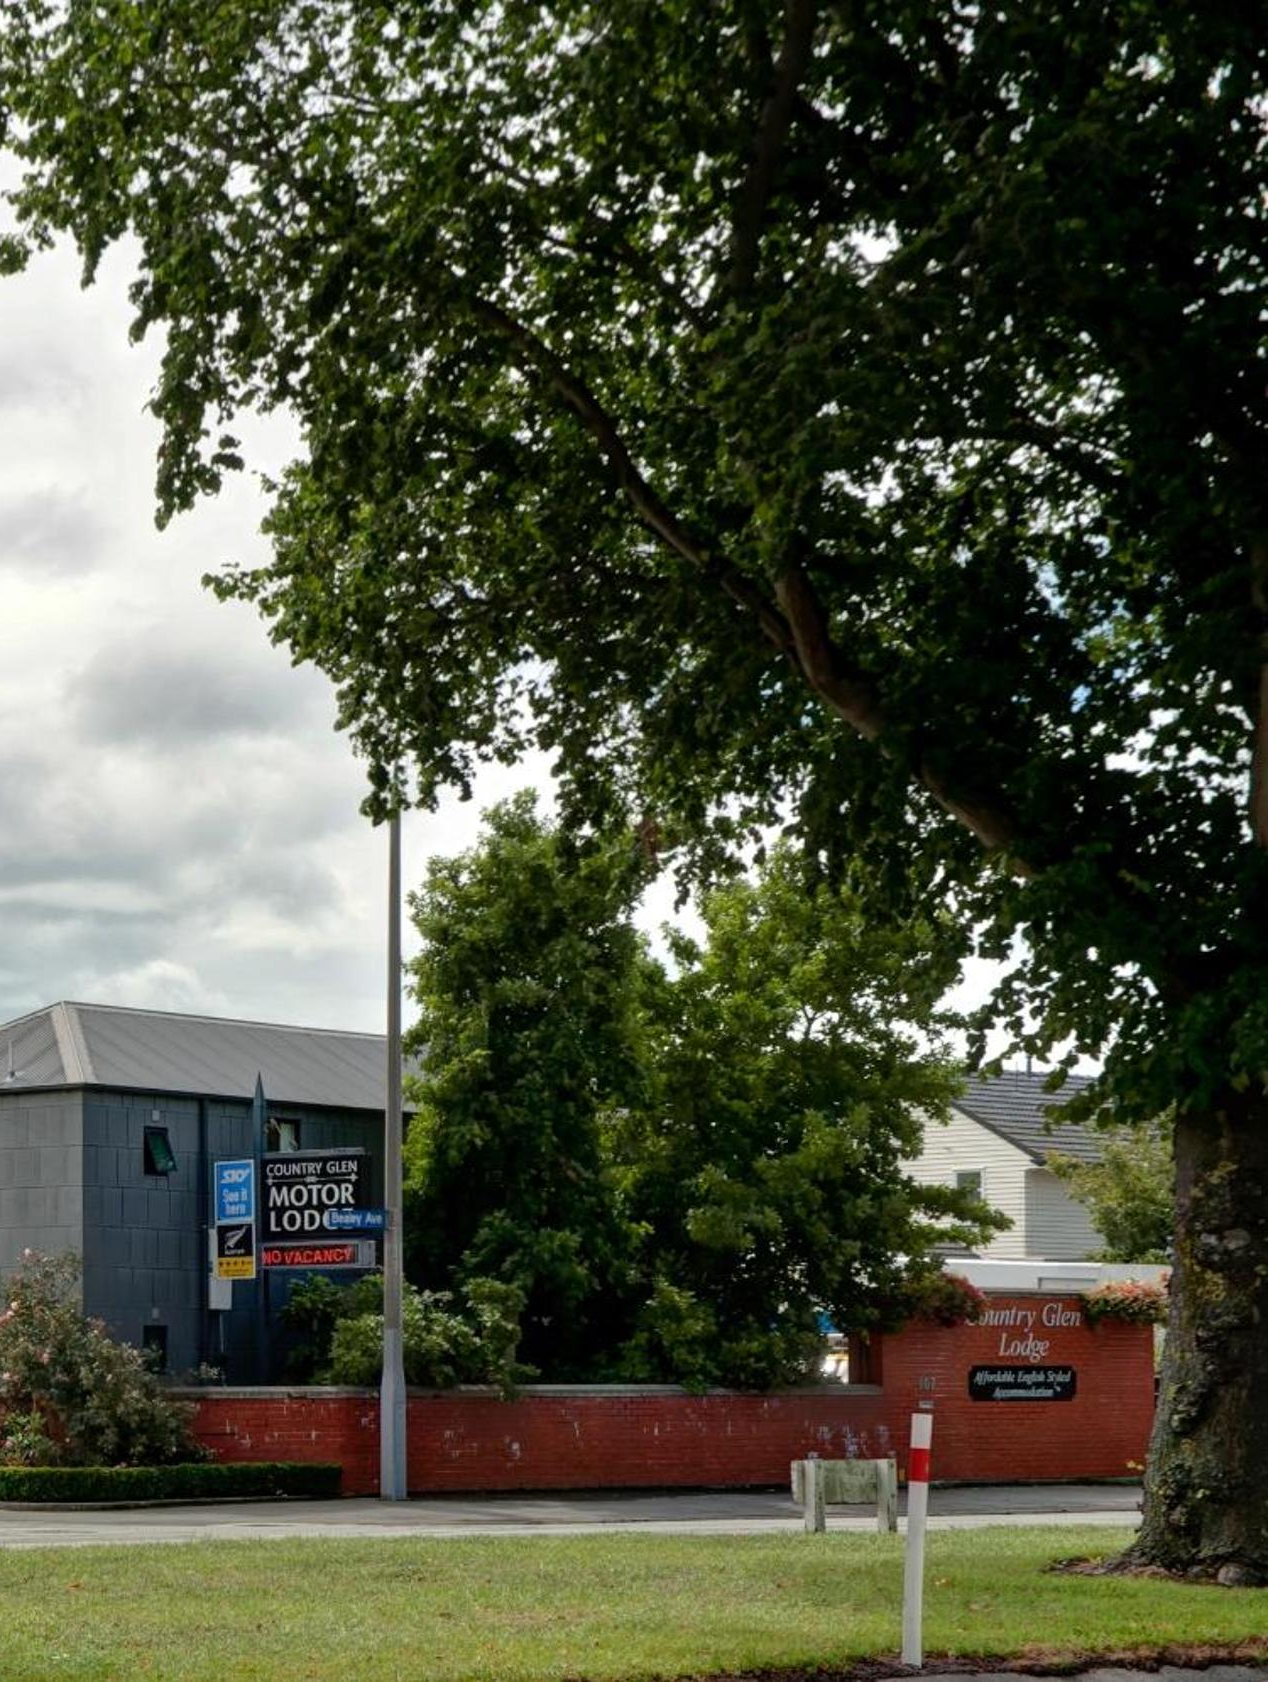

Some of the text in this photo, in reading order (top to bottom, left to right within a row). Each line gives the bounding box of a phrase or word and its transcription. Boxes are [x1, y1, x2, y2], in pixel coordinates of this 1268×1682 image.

[220, 1168, 250, 1183] SKY
[266, 1160, 357, 1176] COUNTRY GLEN
[269, 1183, 355, 1207] MOTOR
[270, 1208, 353, 1231] LOD
[365, 1211, 383, 1224] Ave
[262, 1250, 281, 1265] NO
[284, 1247, 350, 1264] VACANCY
[1042, 1303, 1081, 1326] Glen
[998, 1332, 1050, 1363] Lodge
[973, 1370, 1015, 1385] Affordable
[1017, 1370, 1046, 1384] English
